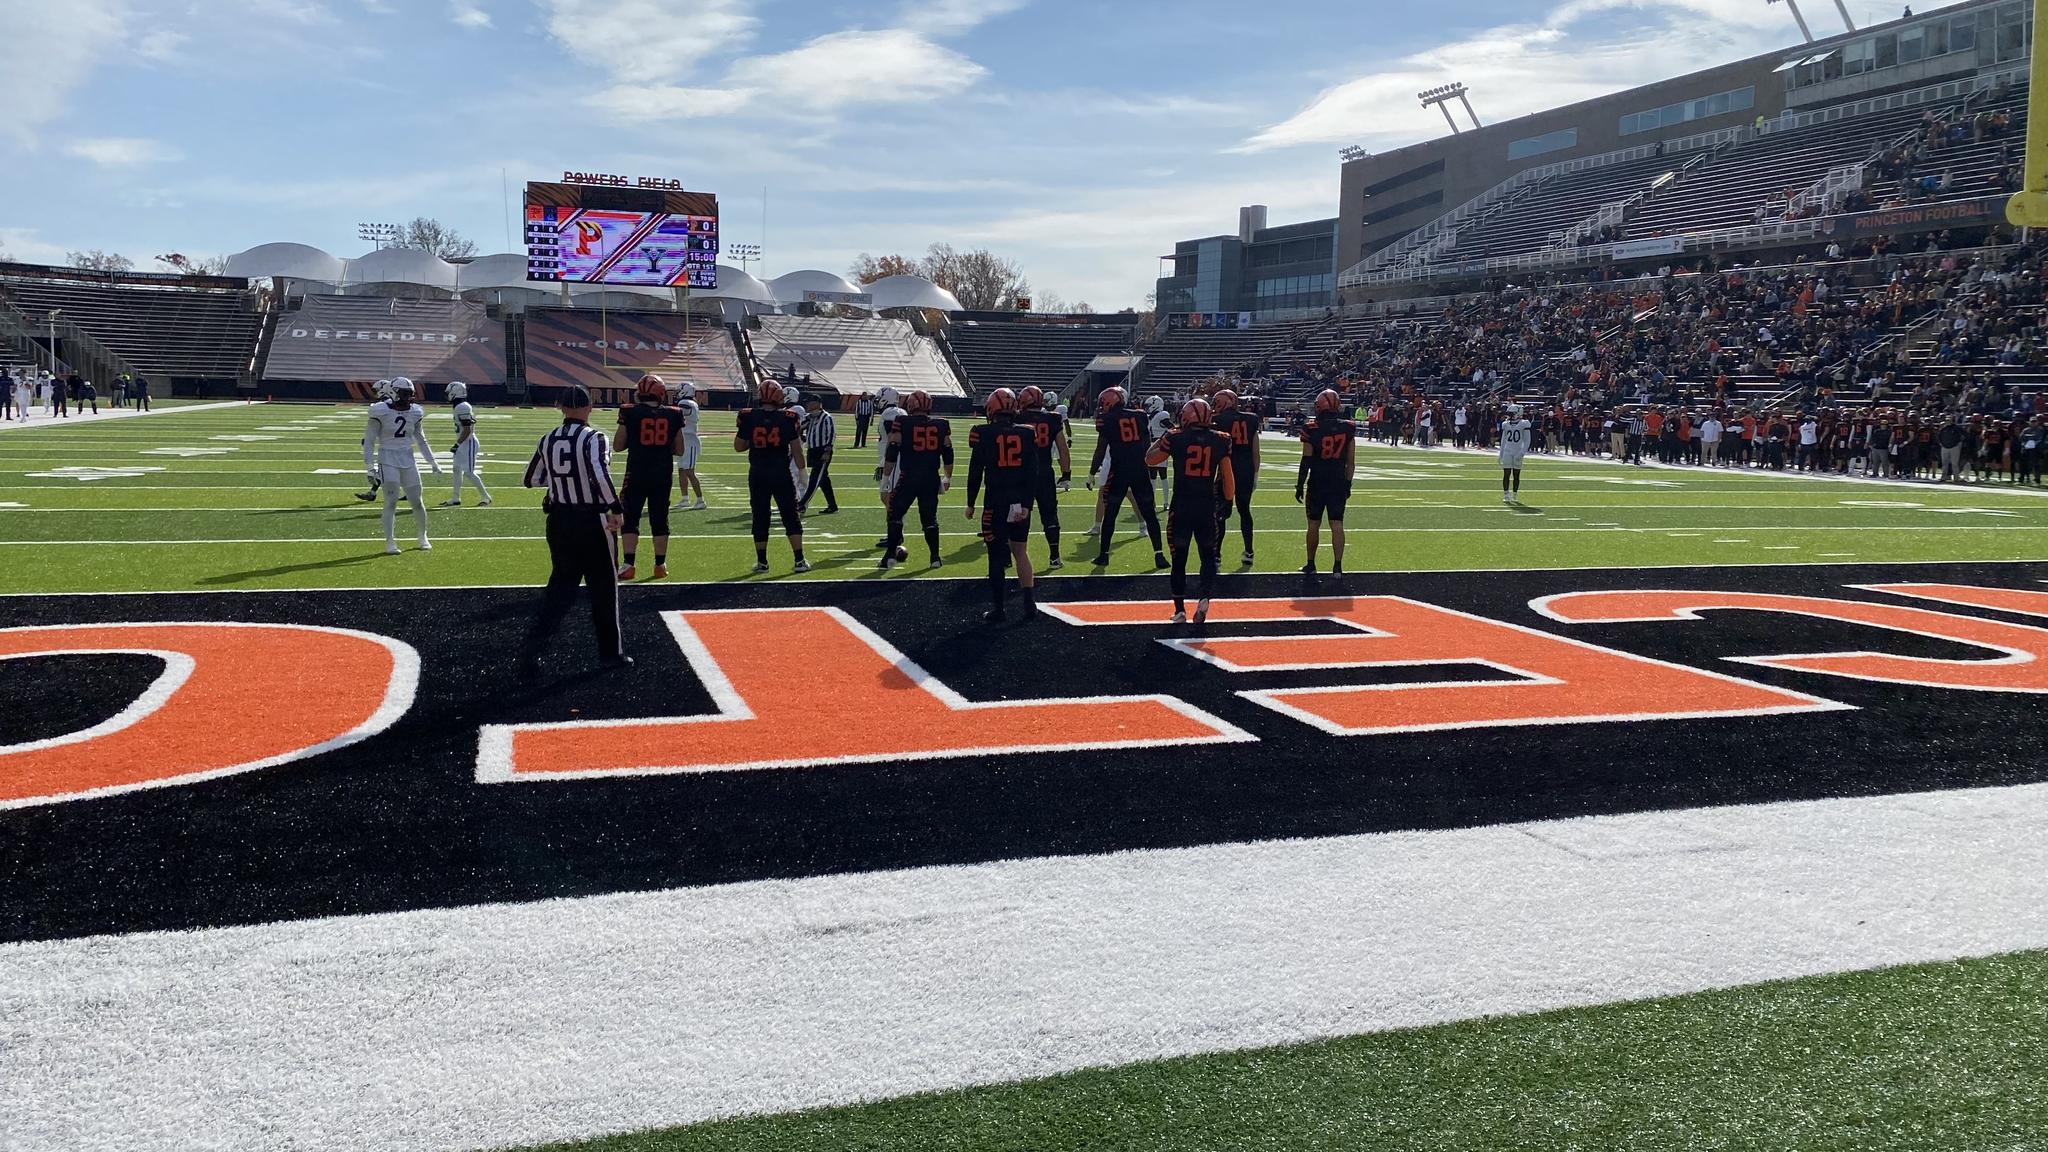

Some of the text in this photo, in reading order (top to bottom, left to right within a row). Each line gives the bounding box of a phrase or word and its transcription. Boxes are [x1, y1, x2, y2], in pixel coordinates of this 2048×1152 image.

[564, 171, 681, 190] POWERS FIELD
[702, 222, 710, 230] 0
[1856, 202, 1992, 228] PRINCETON FOOTBALL
[576, 220, 602, 255] P
[703, 240, 710, 249] 0
[641, 247, 667, 272] Y
[690, 252, 714, 262] 15:00
[1018, 300, 1030, 308] 25
[291, 328, 457, 342] DEFENDER
[554, 340, 588, 348] THE
[394, 416, 406, 438] 2
[640, 418, 668, 446] 68
[752, 426, 780, 448] 64
[912, 426, 938, 451] 56
[1119, 418, 1140, 442] 61
[1231, 420, 1248, 445] 41
[1507, 430, 1520, 442] 20
[552, 440, 572, 474] C
[996, 434, 1022, 467] 12
[1321, 433, 1347, 460] 87
[1184, 445, 1212, 477] 21
